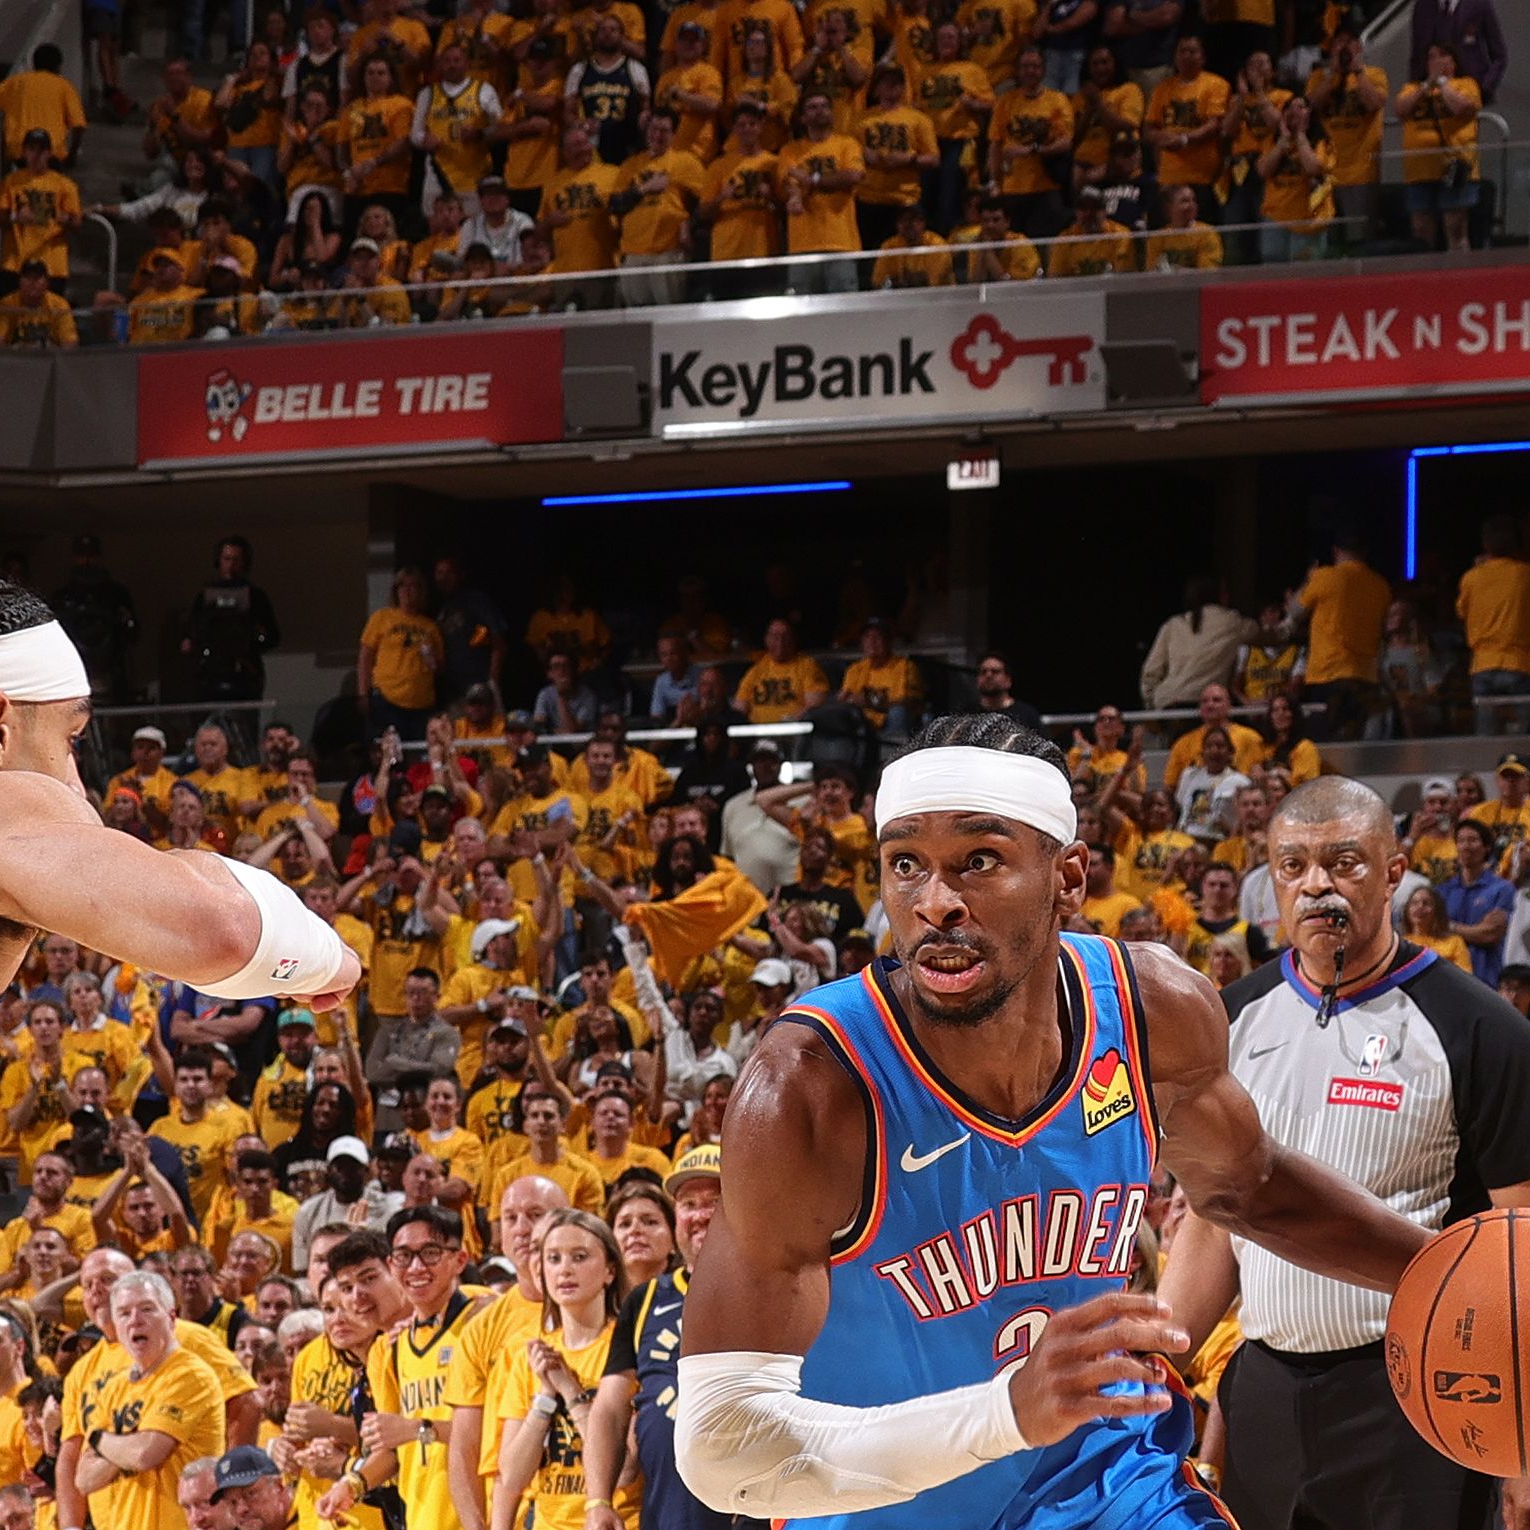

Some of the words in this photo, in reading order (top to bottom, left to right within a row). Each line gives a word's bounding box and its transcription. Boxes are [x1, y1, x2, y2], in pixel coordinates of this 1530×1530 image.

[1215, 308, 1401, 369] STEAK
[1414, 313, 1441, 349] N
[254, 384, 393, 424] BELLE
[394, 374, 491, 414] TIRE
[660, 338, 935, 417] KeyBank
[1330, 1082, 1402, 1104] Emirates
[680, 1155, 721, 1171] INDIAN
[875, 1184, 1147, 1321] THUNDER
[402, 1375, 447, 1414] NDIAN
[554, 1474, 587, 1496] FINAL
